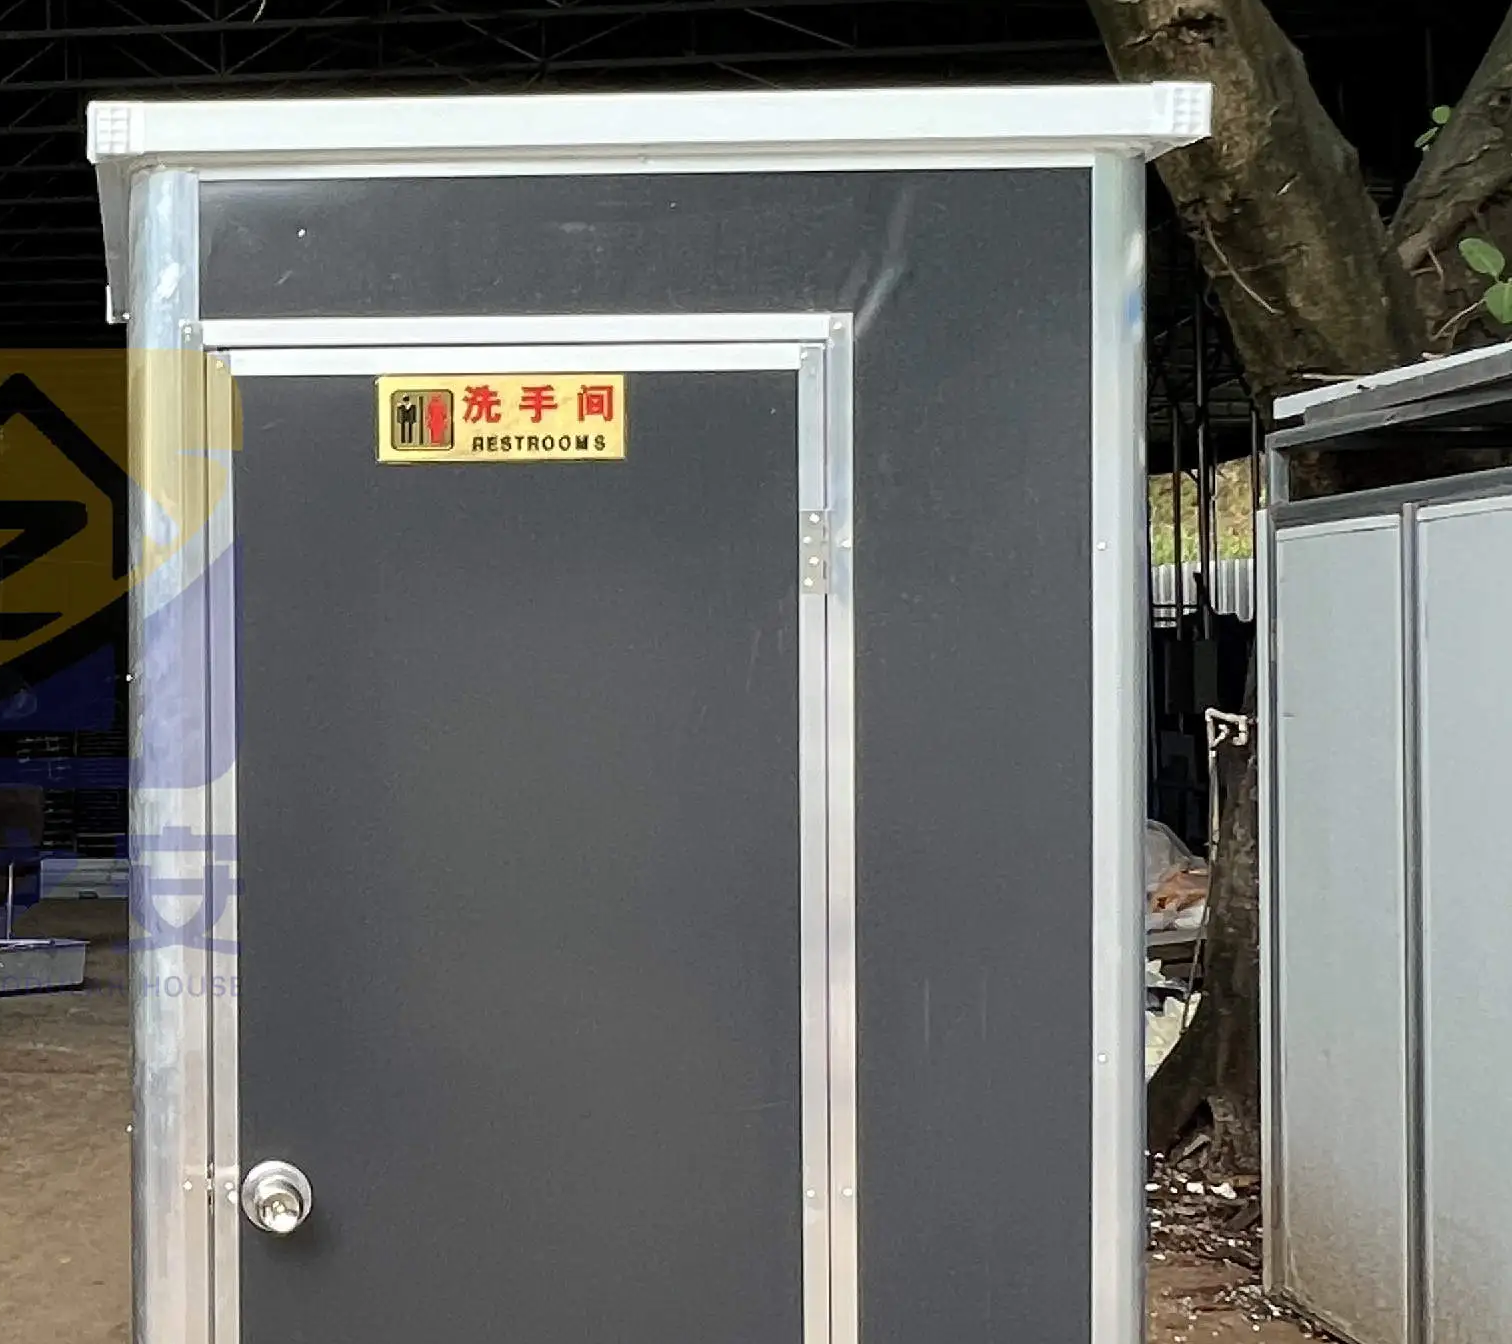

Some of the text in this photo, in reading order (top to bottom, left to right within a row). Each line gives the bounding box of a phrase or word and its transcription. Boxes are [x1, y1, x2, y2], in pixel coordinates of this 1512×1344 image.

[461, 384, 615, 424] 洗手间
[471, 434, 607, 453] RESTROOMS
